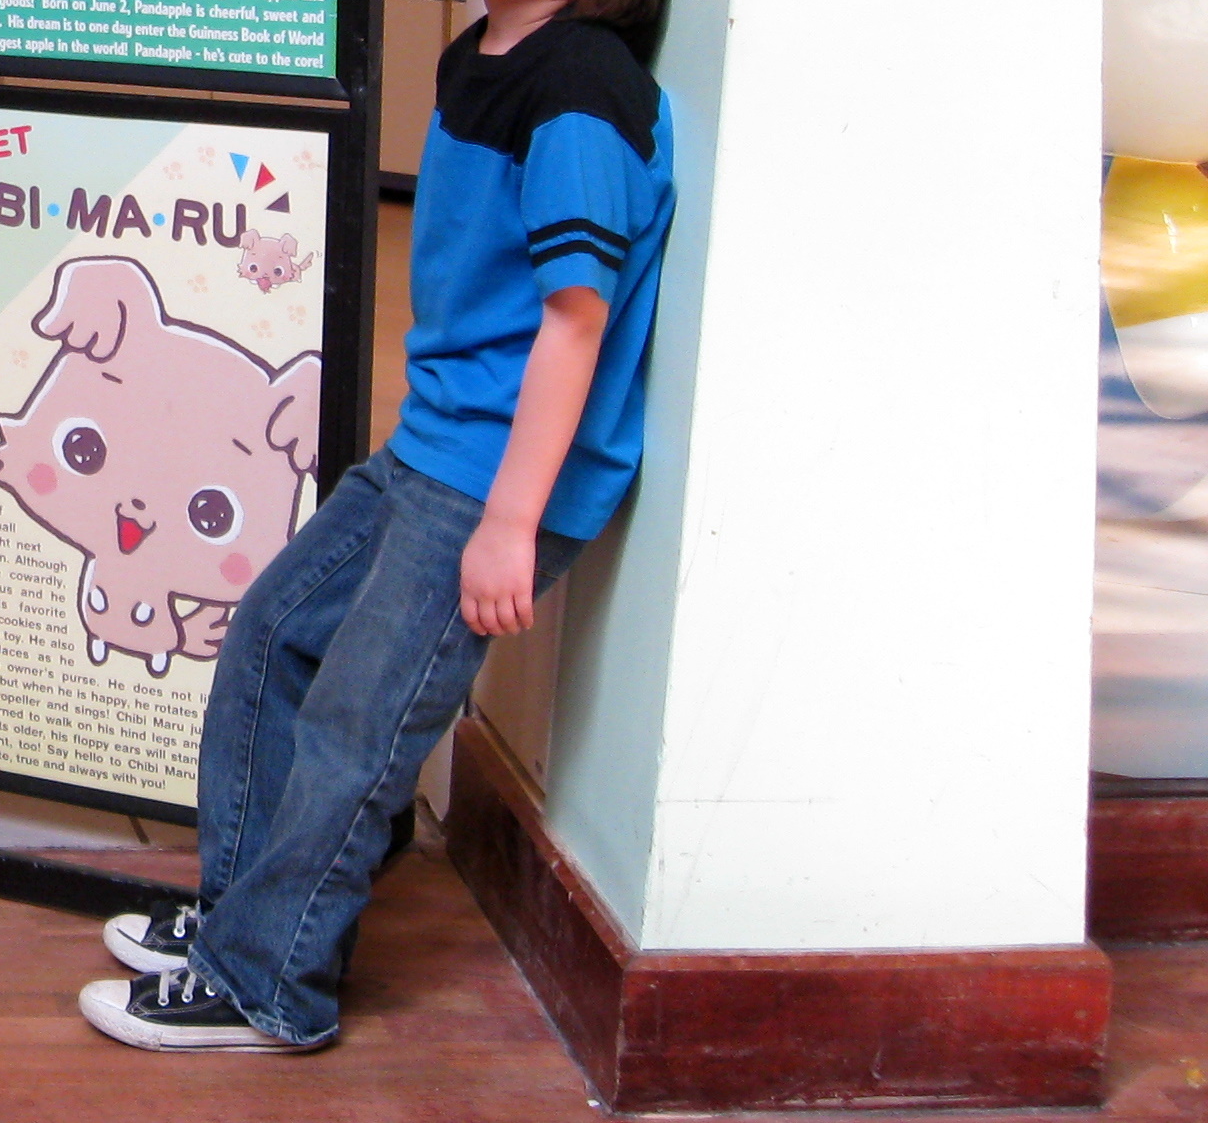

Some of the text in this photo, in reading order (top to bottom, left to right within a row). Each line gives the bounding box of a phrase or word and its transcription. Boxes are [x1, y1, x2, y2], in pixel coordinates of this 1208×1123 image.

[24, 38, 54, 54] apple
[57, 39, 68, 52] in
[70, 39, 90, 54] the
[92, 42, 128, 56] world!
[134, 43, 192, 64] Pandapple
[228, 53, 252, 64] cute
[255, 53, 268, 66] to
[271, 52, 291, 66] the
[294, 54, 323, 69] core!
[16, 541, 40, 552] next
[15, 554, 67, 573] Although
[9, 572, 65, 589] cowardly,
[19, 601, 66, 618] favorite
[16, 753, 39, 766] true
[43, 760, 65, 771] and
[68, 764, 108, 780] always
[112, 773, 137, 785] with
[140, 778, 166, 789] you!
